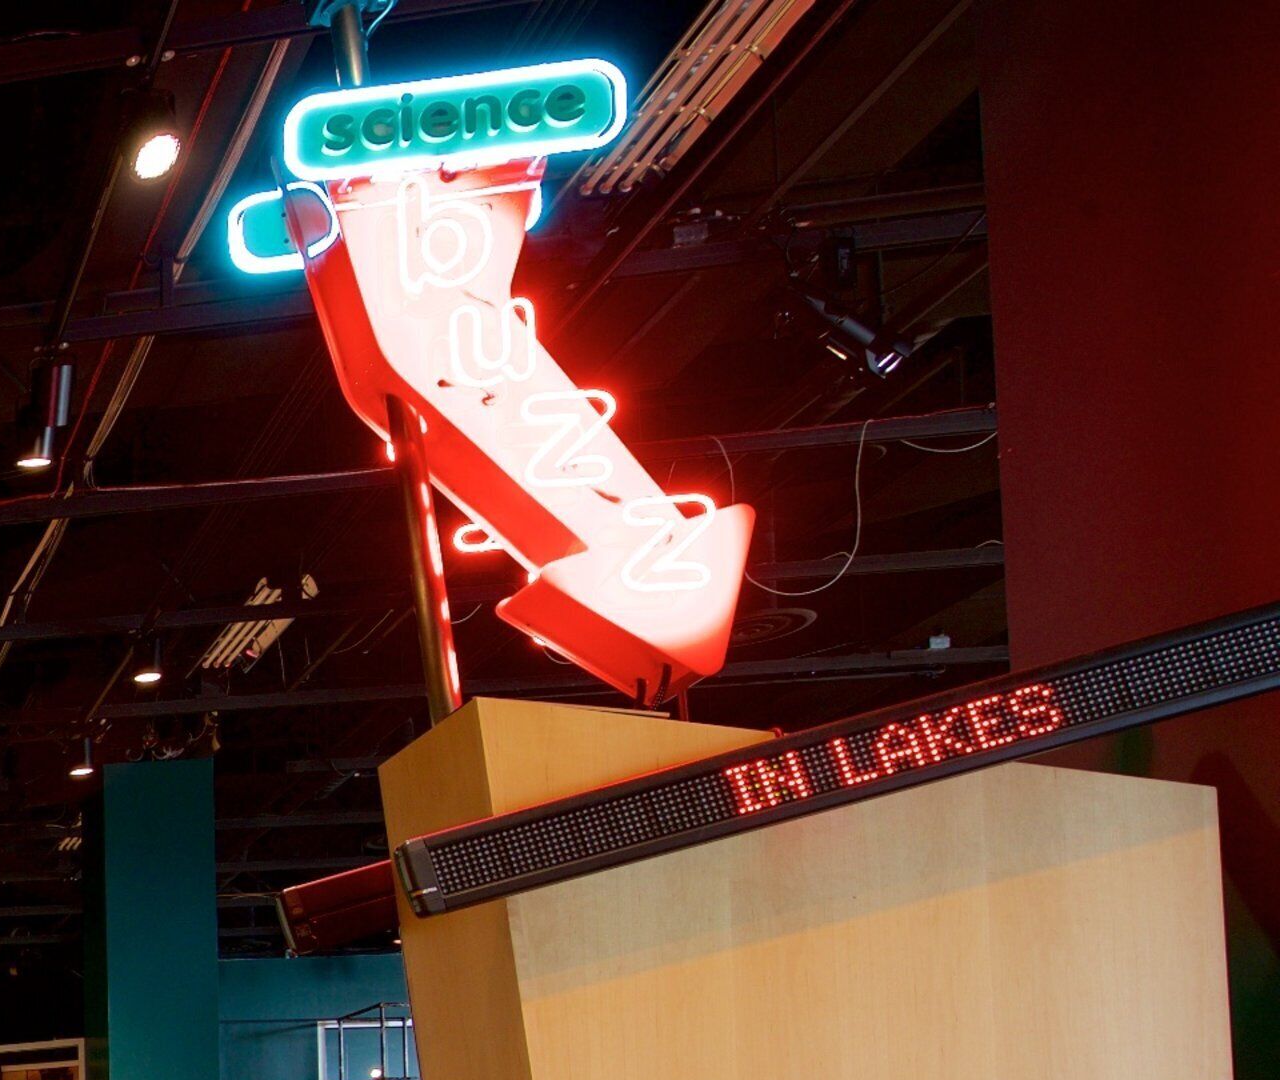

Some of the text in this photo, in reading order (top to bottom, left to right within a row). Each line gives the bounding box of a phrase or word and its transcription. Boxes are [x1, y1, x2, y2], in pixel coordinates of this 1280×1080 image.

[321, 84, 587, 156] science
[396, 173, 716, 592] buzz
[725, 683, 1062, 814] IN LAKES
